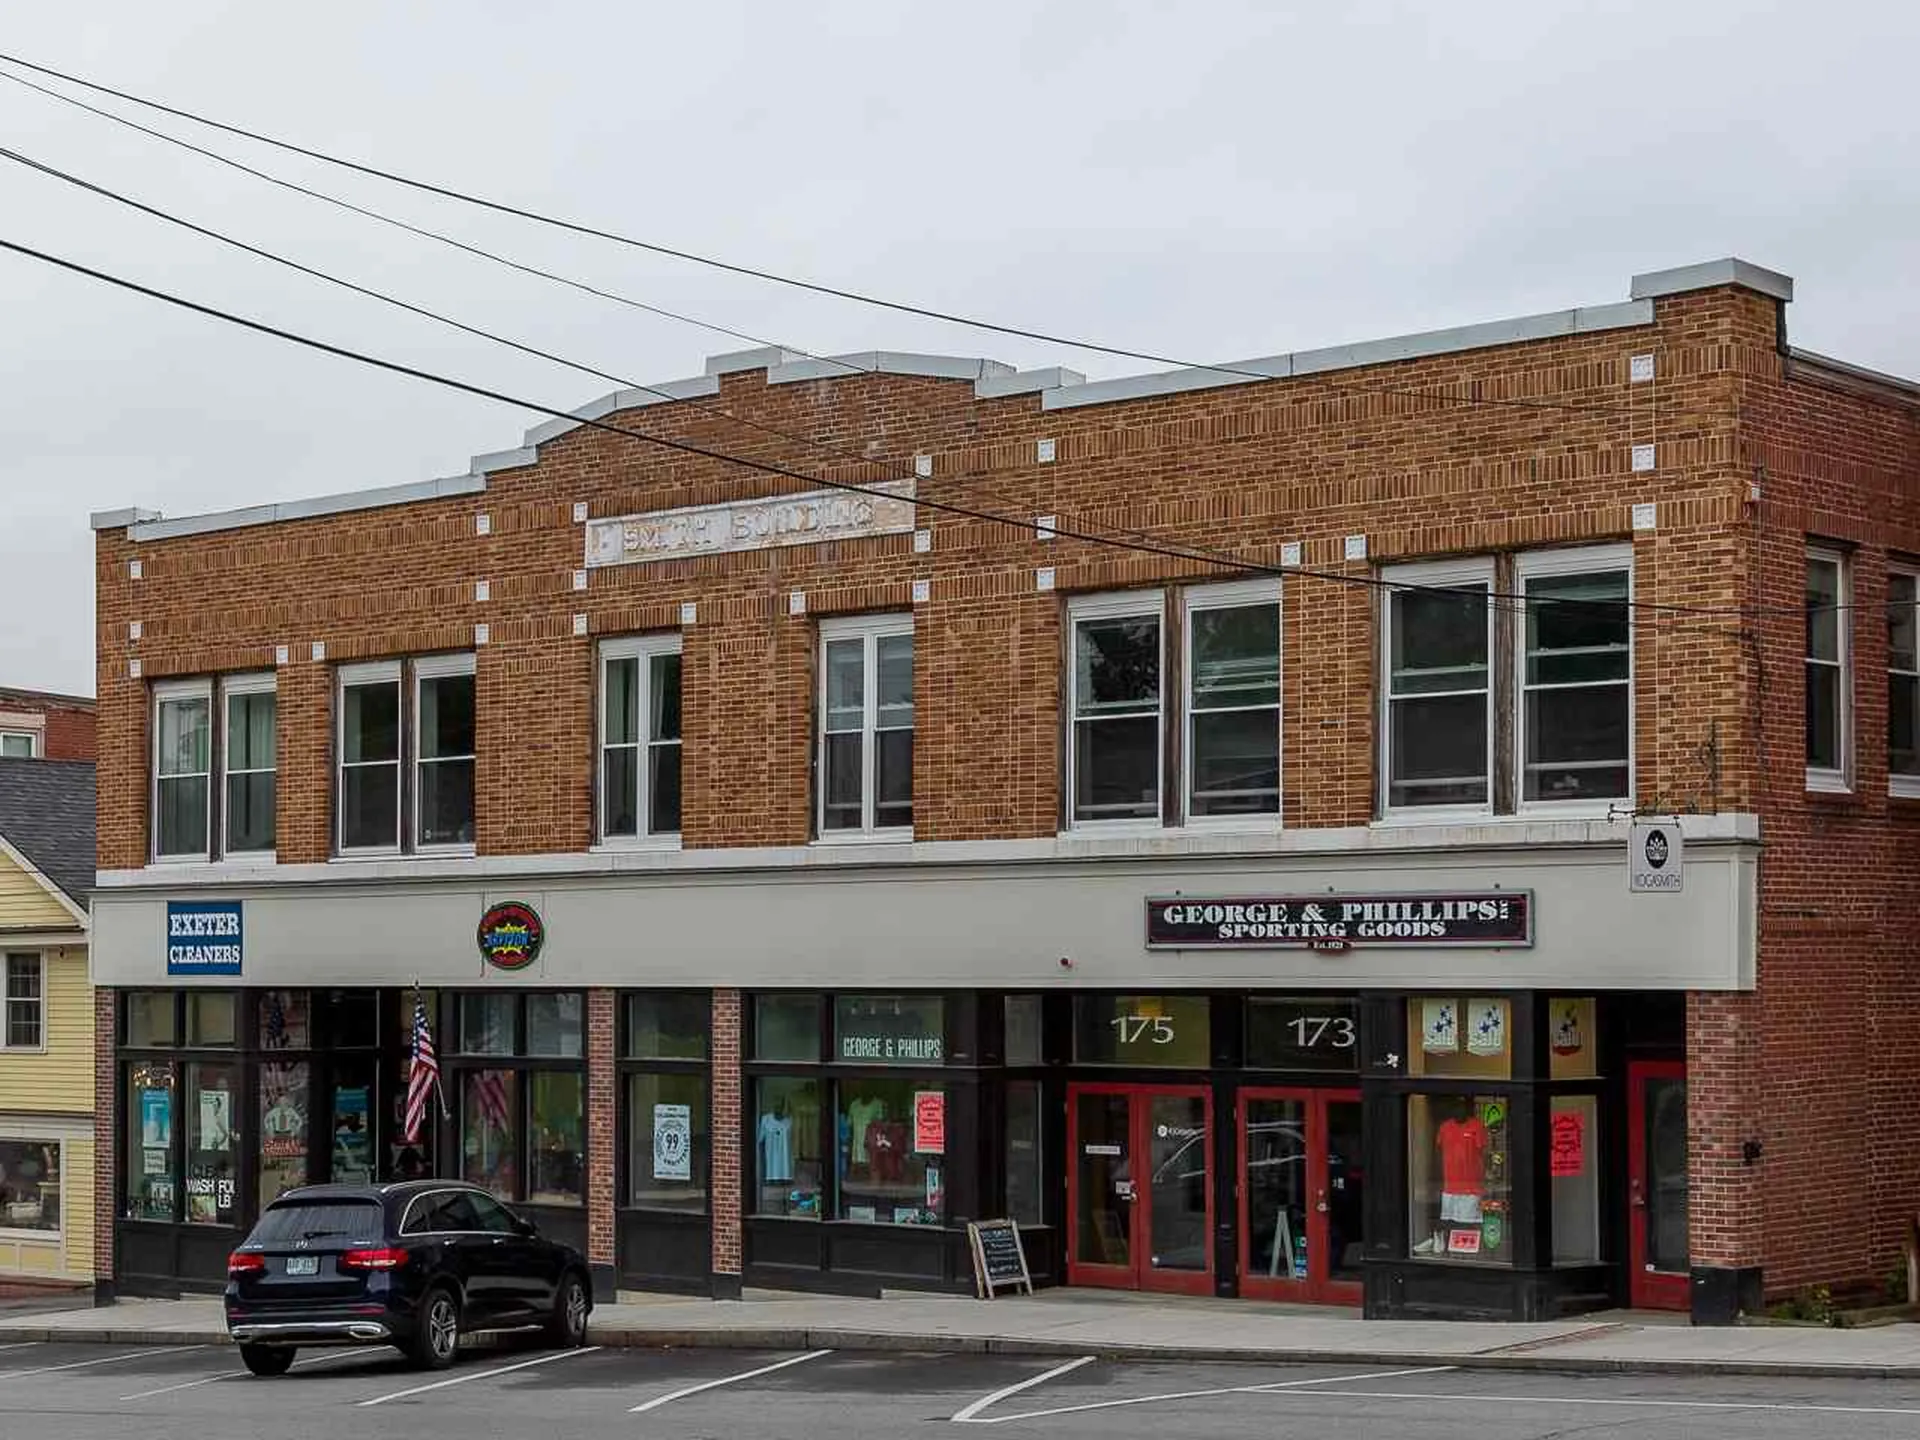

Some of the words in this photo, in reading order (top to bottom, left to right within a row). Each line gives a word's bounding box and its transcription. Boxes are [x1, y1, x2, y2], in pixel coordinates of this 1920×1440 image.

[623, 516, 712, 551] SMITH
[732, 498, 876, 540] BUILDING
[1163, 902, 1290, 925] GEORGE
[1301, 902, 1326, 922] &
[1342, 899, 1498, 922] PHILLIPS
[169, 912, 240, 936] EXETER
[1218, 922, 1347, 939] SPORTING
[1358, 921, 1446, 937] GOODS
[169, 944, 241, 965] CLEANERS
[1110, 1016, 1175, 1044] 175
[1287, 1017, 1356, 1048] 173
[843, 1037, 881, 1057] GEORGE
[886, 1038, 893, 1057] &
[898, 1038, 941, 1059] PHILLIPS
[665, 1133, 679, 1150] 99
[186, 1178, 215, 1194] WASH
